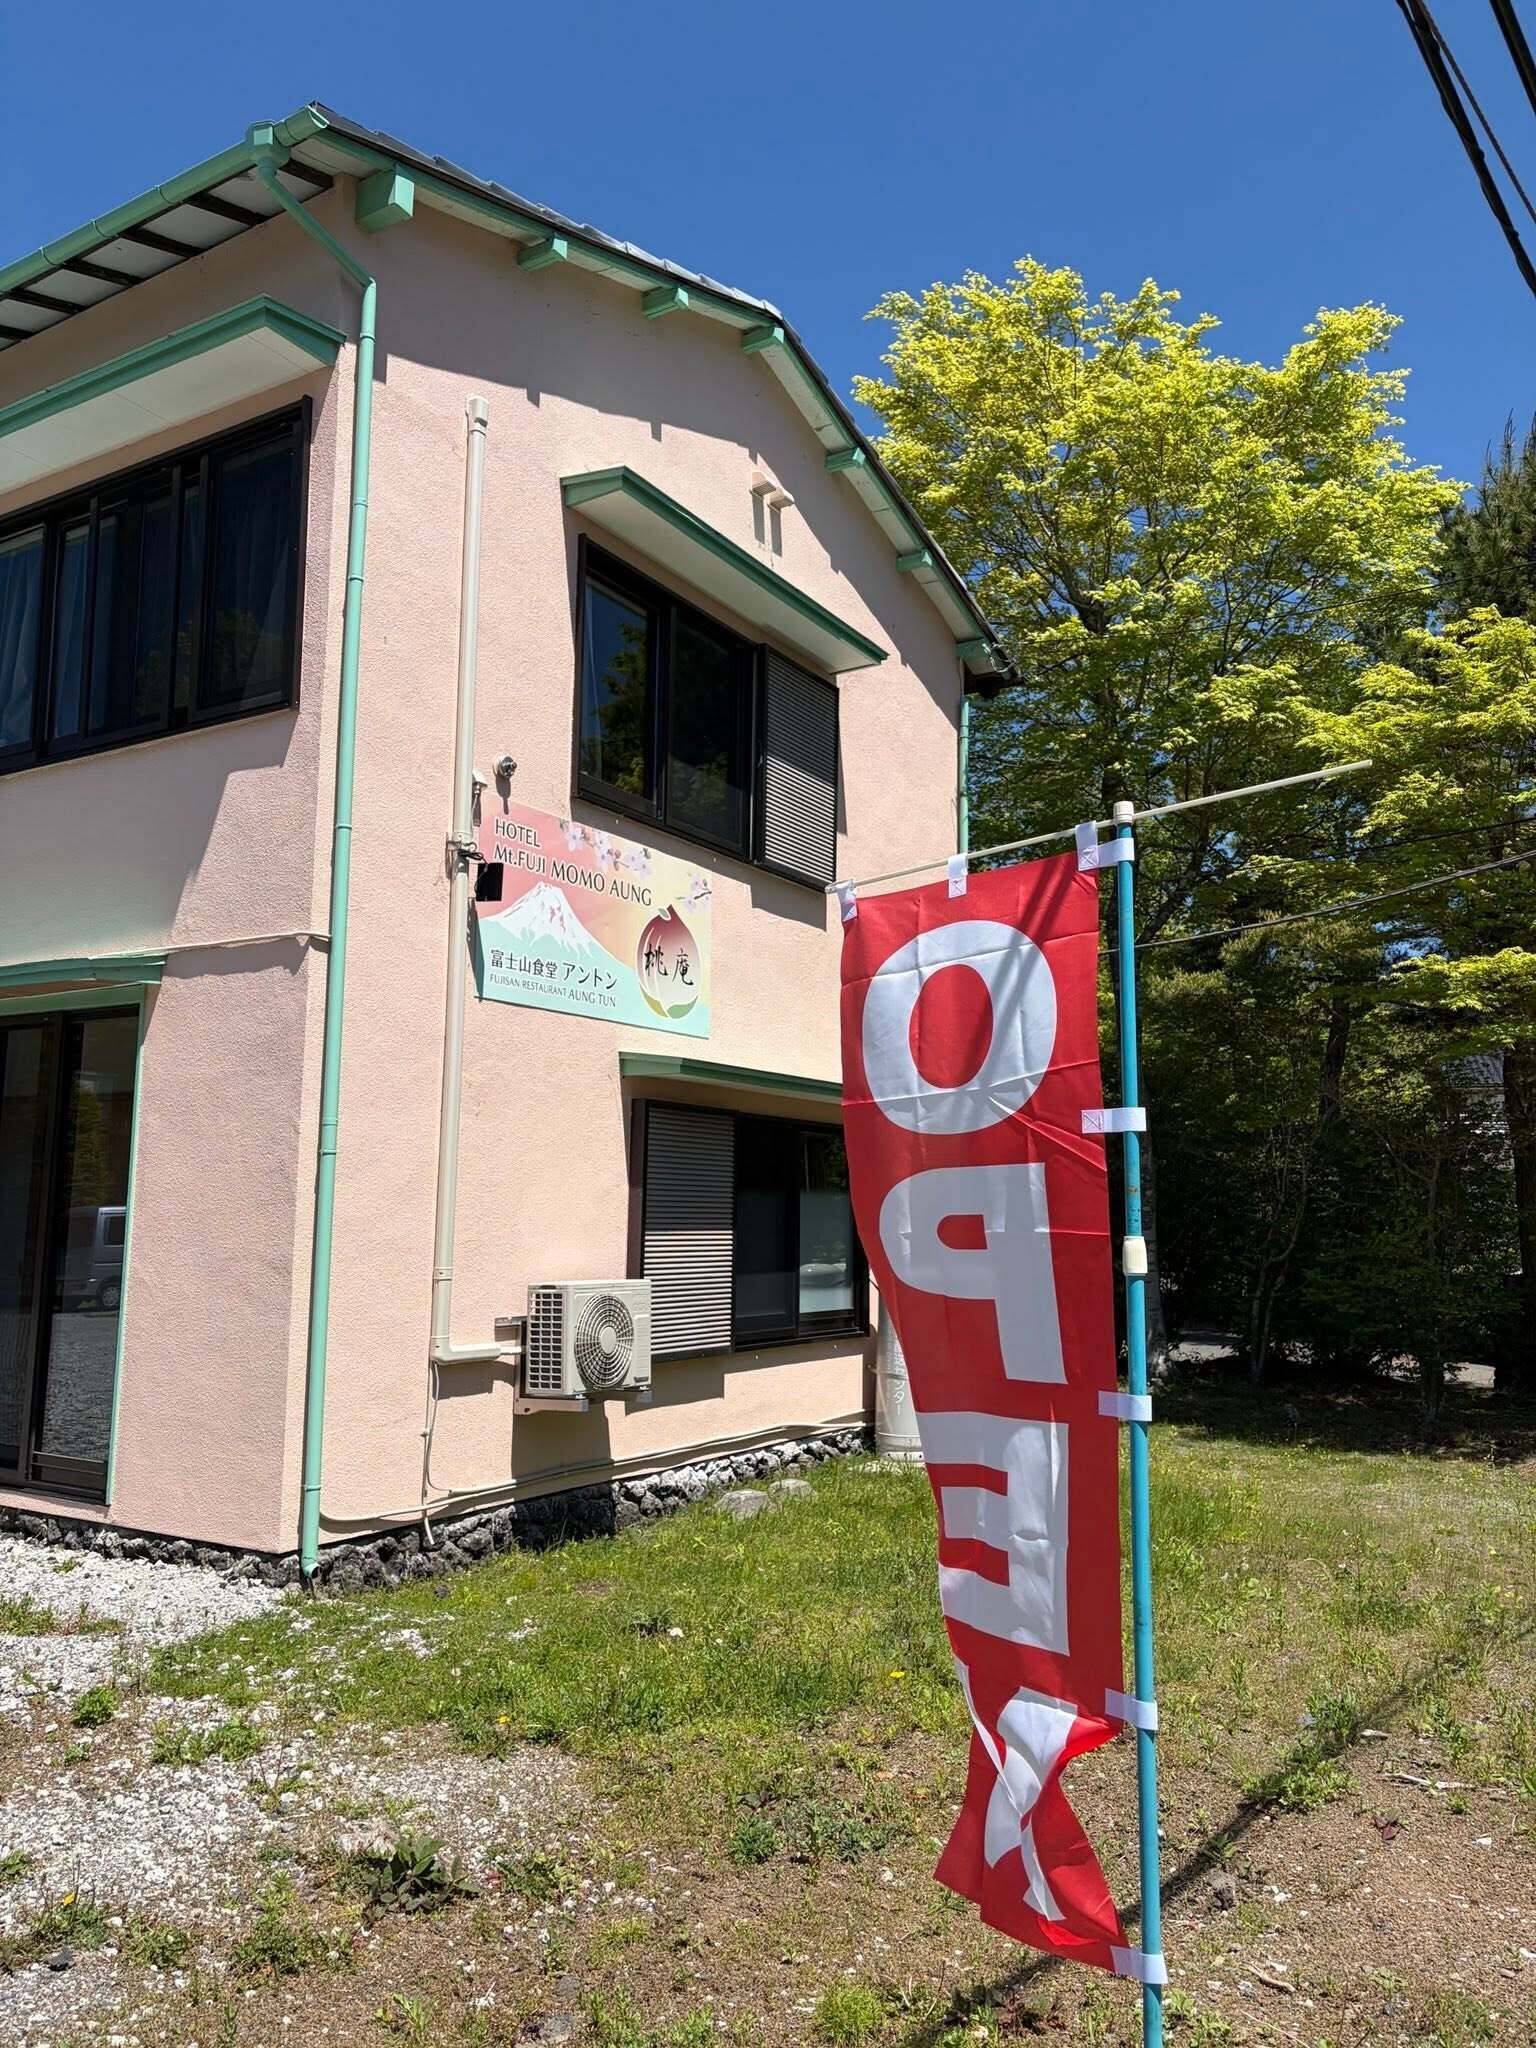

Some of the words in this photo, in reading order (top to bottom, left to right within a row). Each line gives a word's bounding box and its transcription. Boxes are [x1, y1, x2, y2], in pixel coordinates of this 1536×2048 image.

[495, 819, 541, 848] HOTEL
[494, 844, 546, 874] Mt.FUJI
[551, 860, 605, 892] MOMO
[609, 879, 652, 906] AUNG
[490, 949, 558, 980] 富士山食堂
[562, 962, 618, 990] アントン
[644, 944, 694, 986] 桃庵
[489, 973, 521, 988] FUJISAN
[521, 979, 567, 997] RESTAURANT
[568, 988, 596, 1004] AUNG
[597, 993, 617, 1008] TUN
